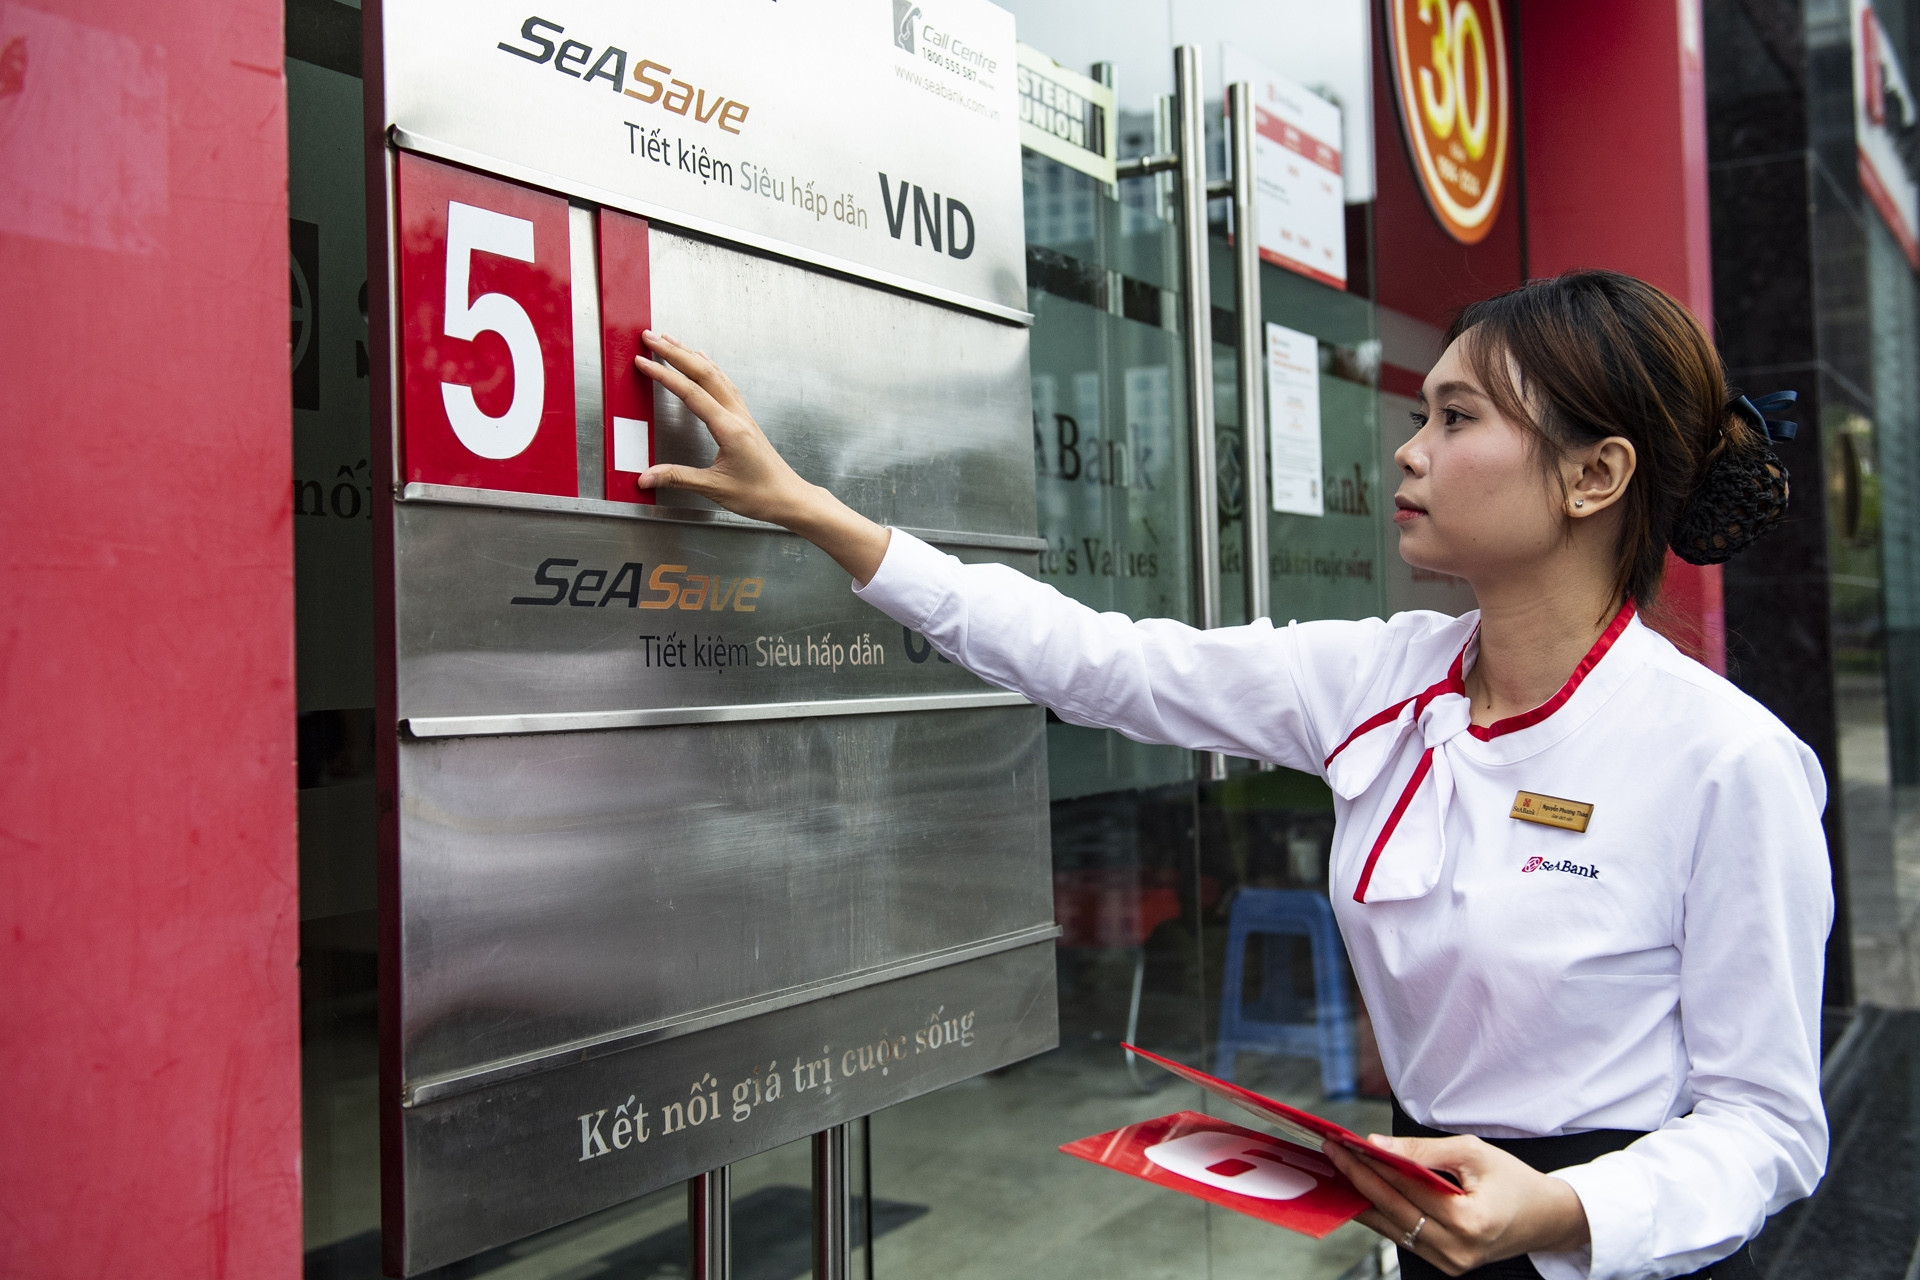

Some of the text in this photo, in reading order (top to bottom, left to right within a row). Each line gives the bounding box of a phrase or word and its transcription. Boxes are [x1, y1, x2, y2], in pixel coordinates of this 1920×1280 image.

[497, 15, 750, 135] SeASave
[921, 47, 977, 83] 1800 555 587
[922, 24, 998, 74] Call Centre
[894, 63, 1000, 121] www.seabank.com.vn
[1418, 0, 1490, 161] 30
[624, 121, 975, 261] Tiết kiệm Siêu hấp dẫn VND
[510, 557, 765, 612] SeASave
[1083, 537, 1159, 578] Values
[639, 631, 687, 668] Tiết
[693, 634, 749, 675] kiệm
[755, 636, 801, 667] Siêu
[806, 632, 844, 674] hấp
[849, 633, 884, 665] dẫn
[1539, 860, 1600, 880] SeABank
[577, 1005, 975, 1163] Kết nối giá trị cuộc sống
